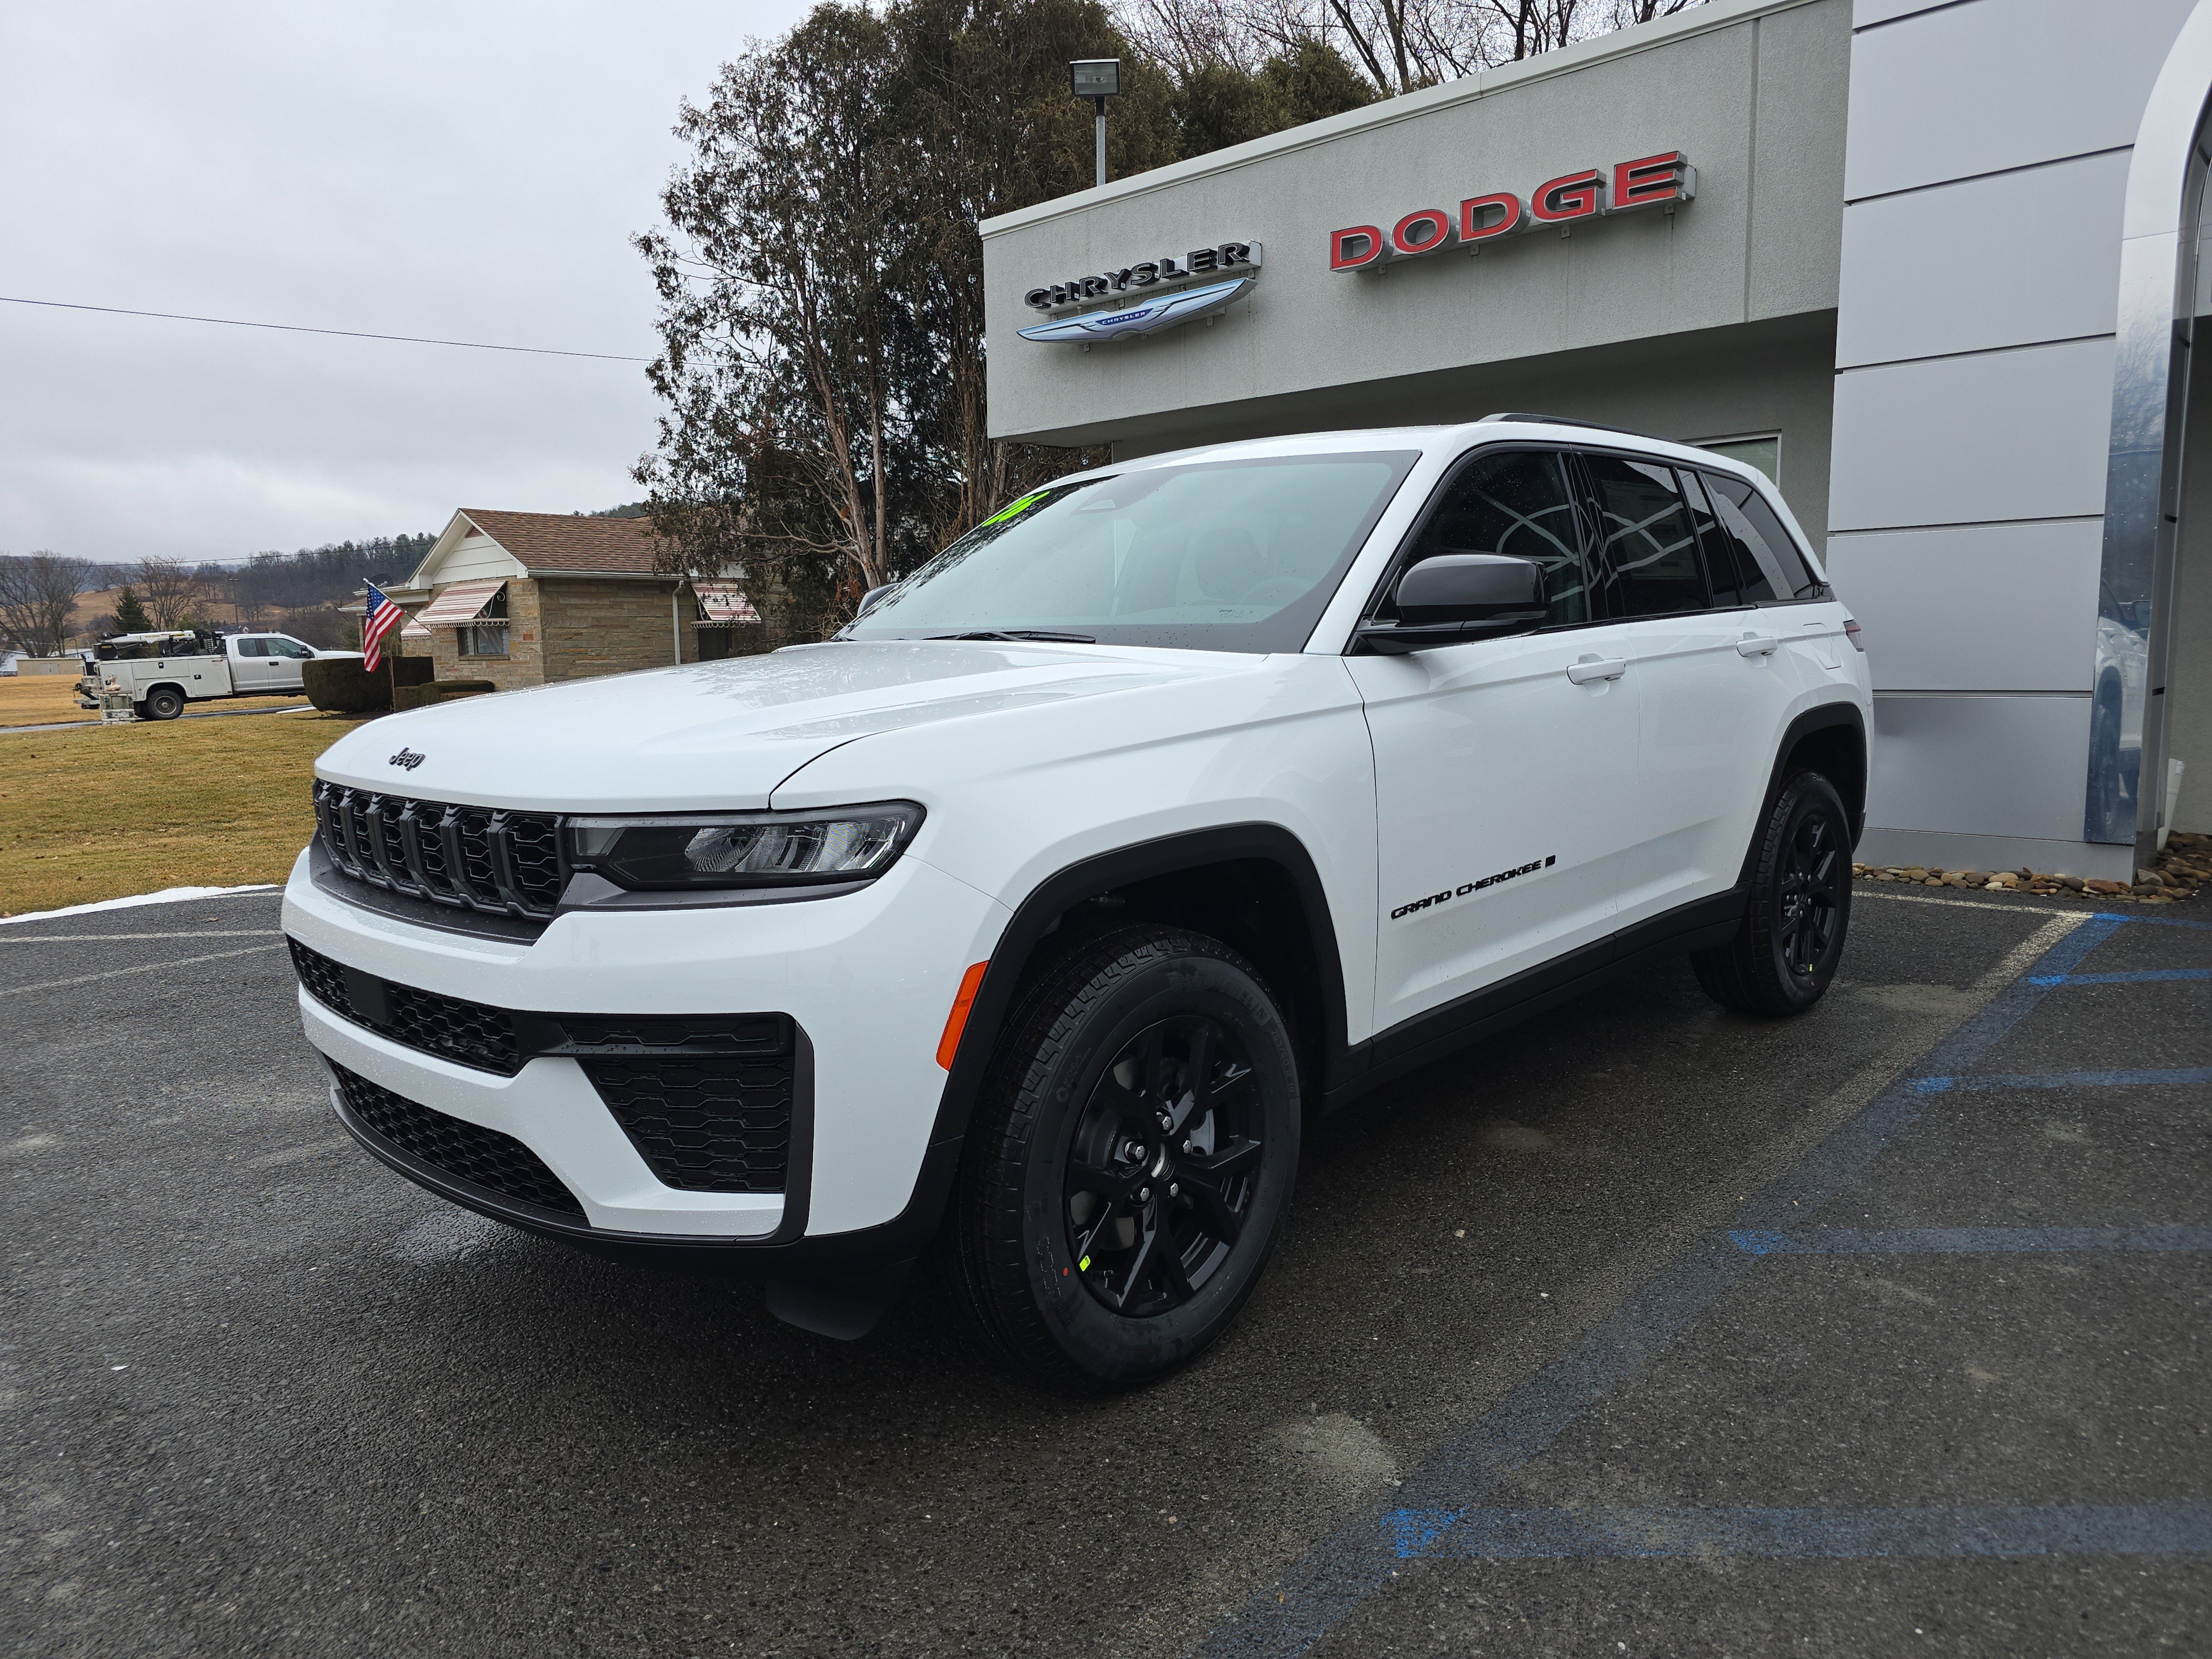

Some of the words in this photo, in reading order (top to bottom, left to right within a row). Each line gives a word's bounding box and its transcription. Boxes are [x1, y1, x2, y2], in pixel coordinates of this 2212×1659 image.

[1330, 151, 1686, 272] DODGE
[1024, 242, 1250, 308] CHRYSLER
[1102, 312, 1146, 324] CHRYSLER
[389, 747, 426, 771] Jeep
[1391, 890, 1452, 920] GRAND
[1456, 859, 1542, 897] CHEROKEE
